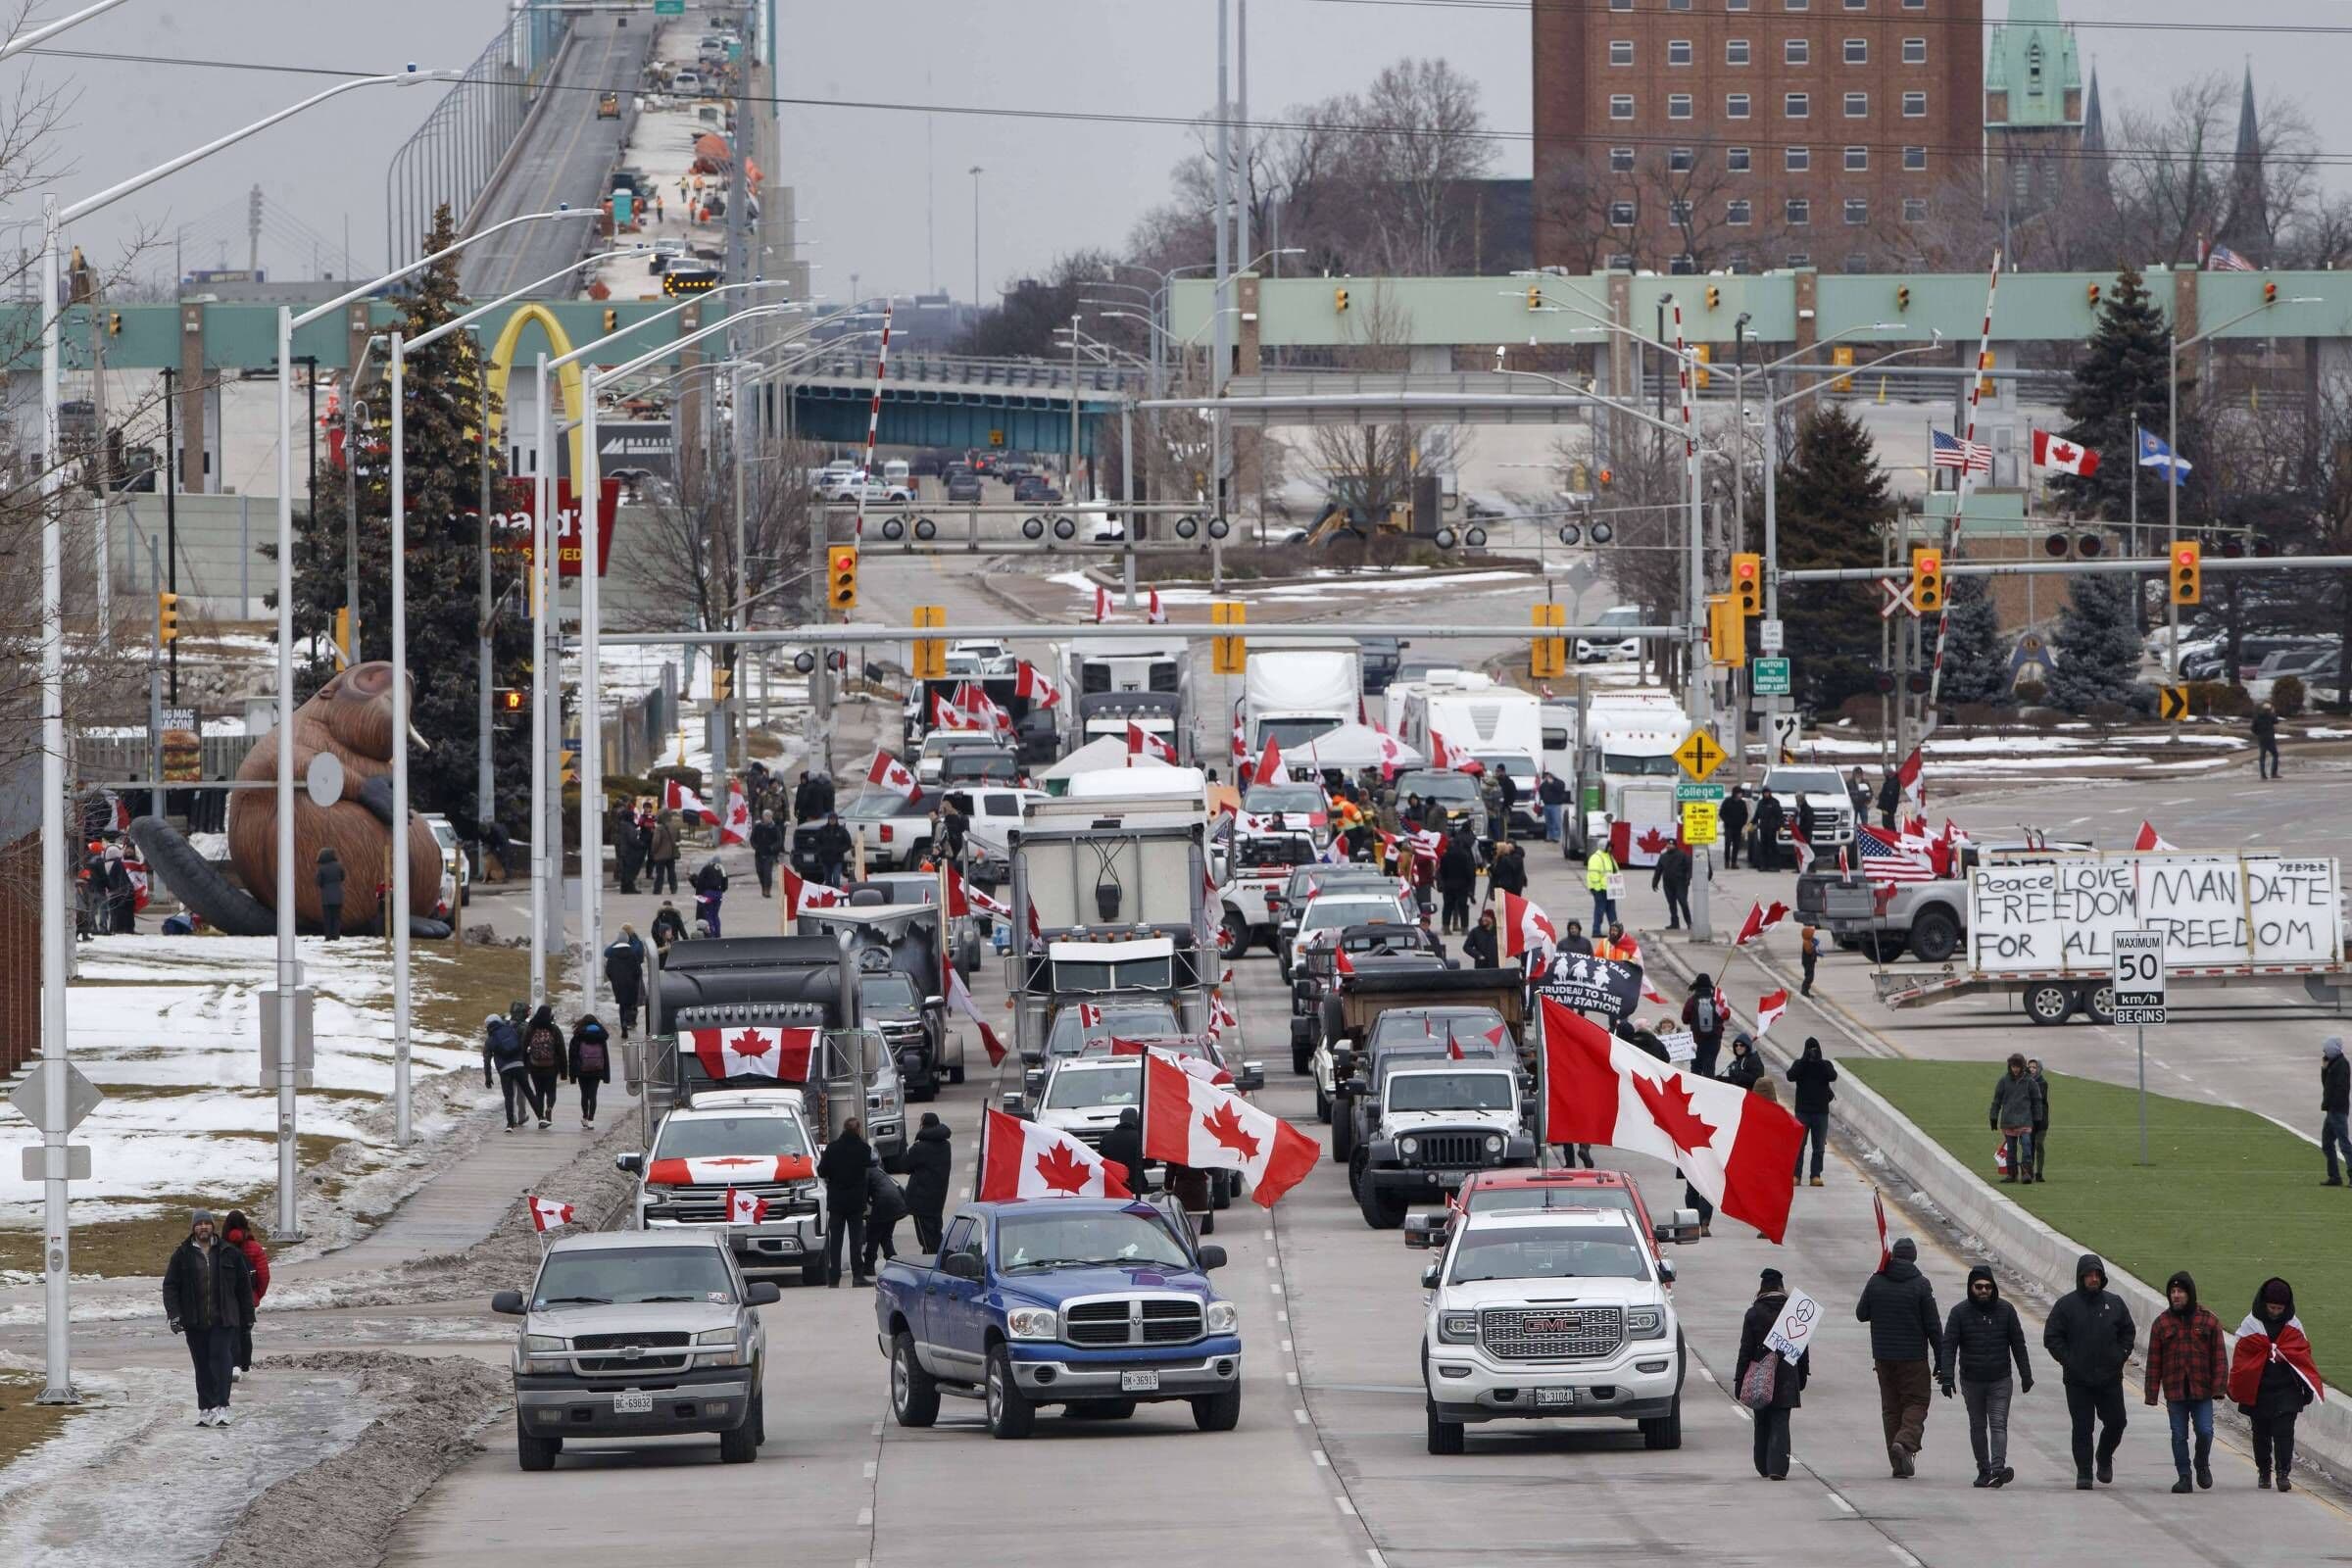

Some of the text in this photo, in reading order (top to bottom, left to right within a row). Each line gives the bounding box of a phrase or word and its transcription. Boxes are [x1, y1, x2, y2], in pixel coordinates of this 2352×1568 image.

[1677, 786, 1715, 799] College
[1976, 868, 2132, 894] Peace LOVE
[1978, 889, 2138, 924] FREEDOM
[1976, 933, 2036, 957] FOR
[2117, 937, 2160, 949] MAXIMUM
[1593, 956, 1606, 964] TO
[1608, 960, 1632, 980] TAKE
[2119, 954, 2158, 982] 50
[1539, 985, 1623, 1006] TRUDEAU TO THE
[2122, 993, 2157, 1004] km/h
[1574, 997, 1621, 1014] STATION
[2117, 1009, 2164, 1023] BEGINS
[1525, 1318, 1580, 1332] GMC
